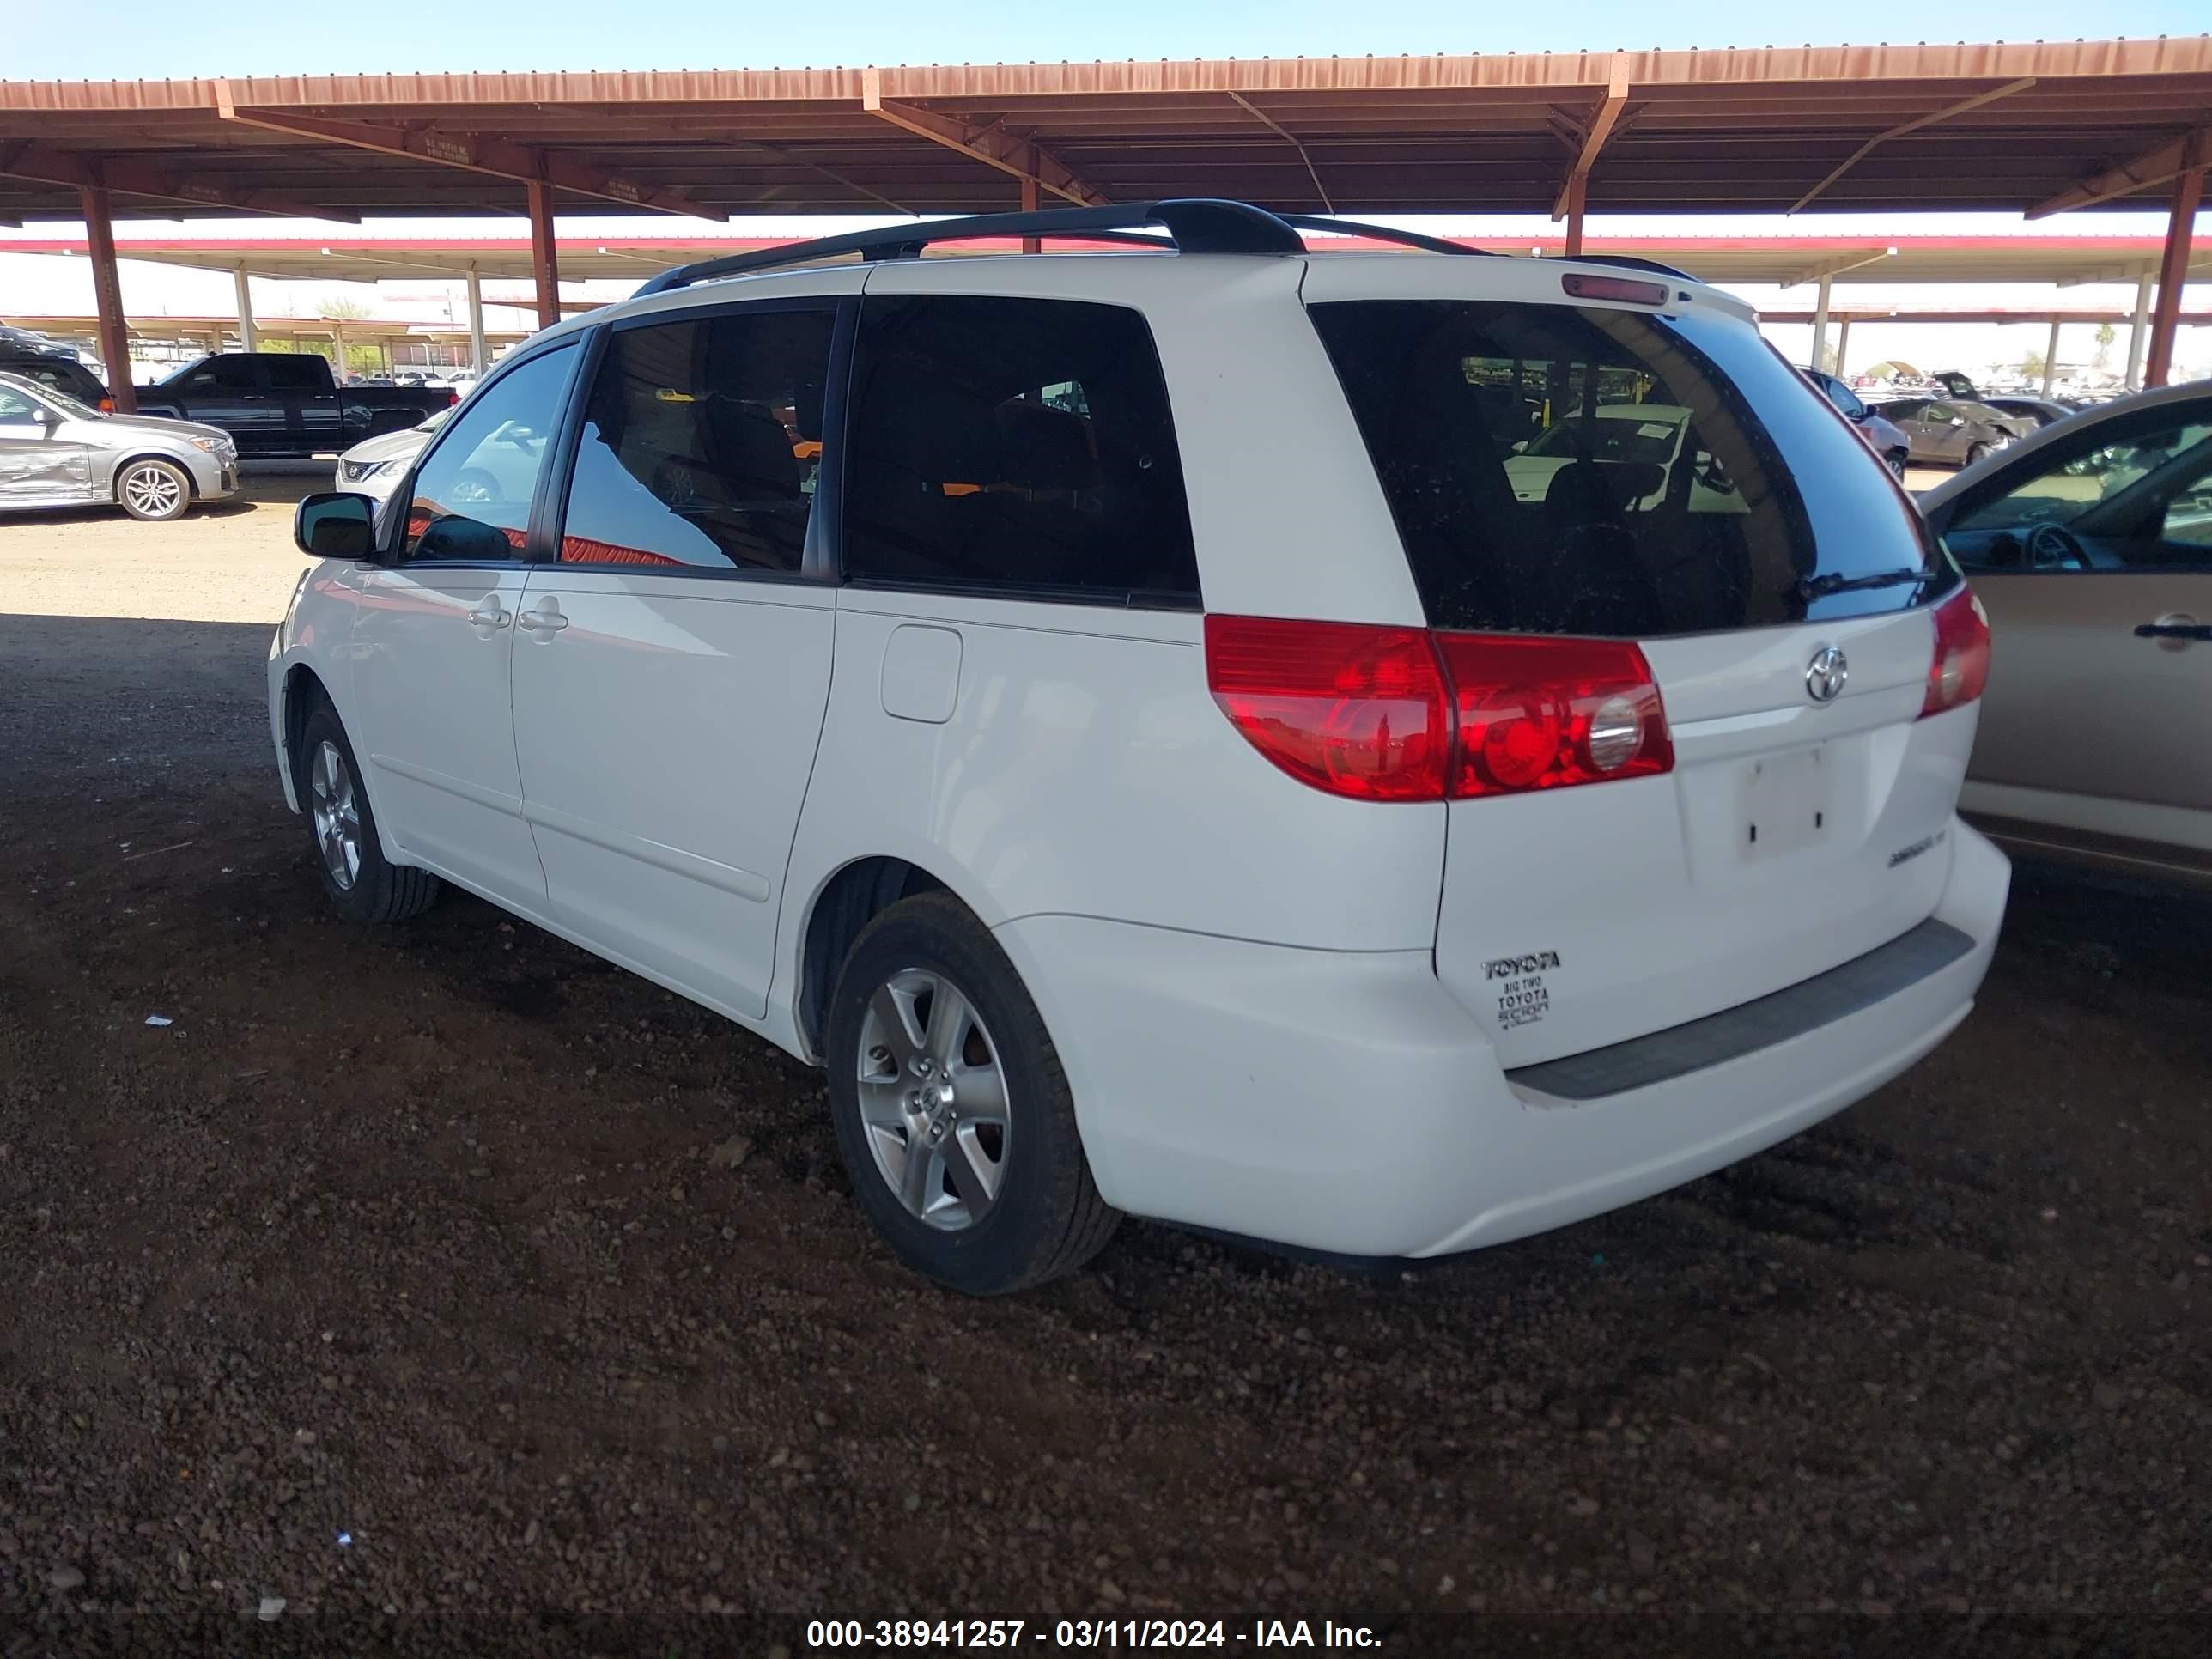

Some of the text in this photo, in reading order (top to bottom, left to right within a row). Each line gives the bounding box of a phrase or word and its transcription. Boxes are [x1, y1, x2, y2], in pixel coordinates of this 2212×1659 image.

[1481, 951, 1561, 980] TOYOTA
[1504, 975, 1542, 994] BIG TWO
[1498, 988, 1549, 1010] TOYOTA
